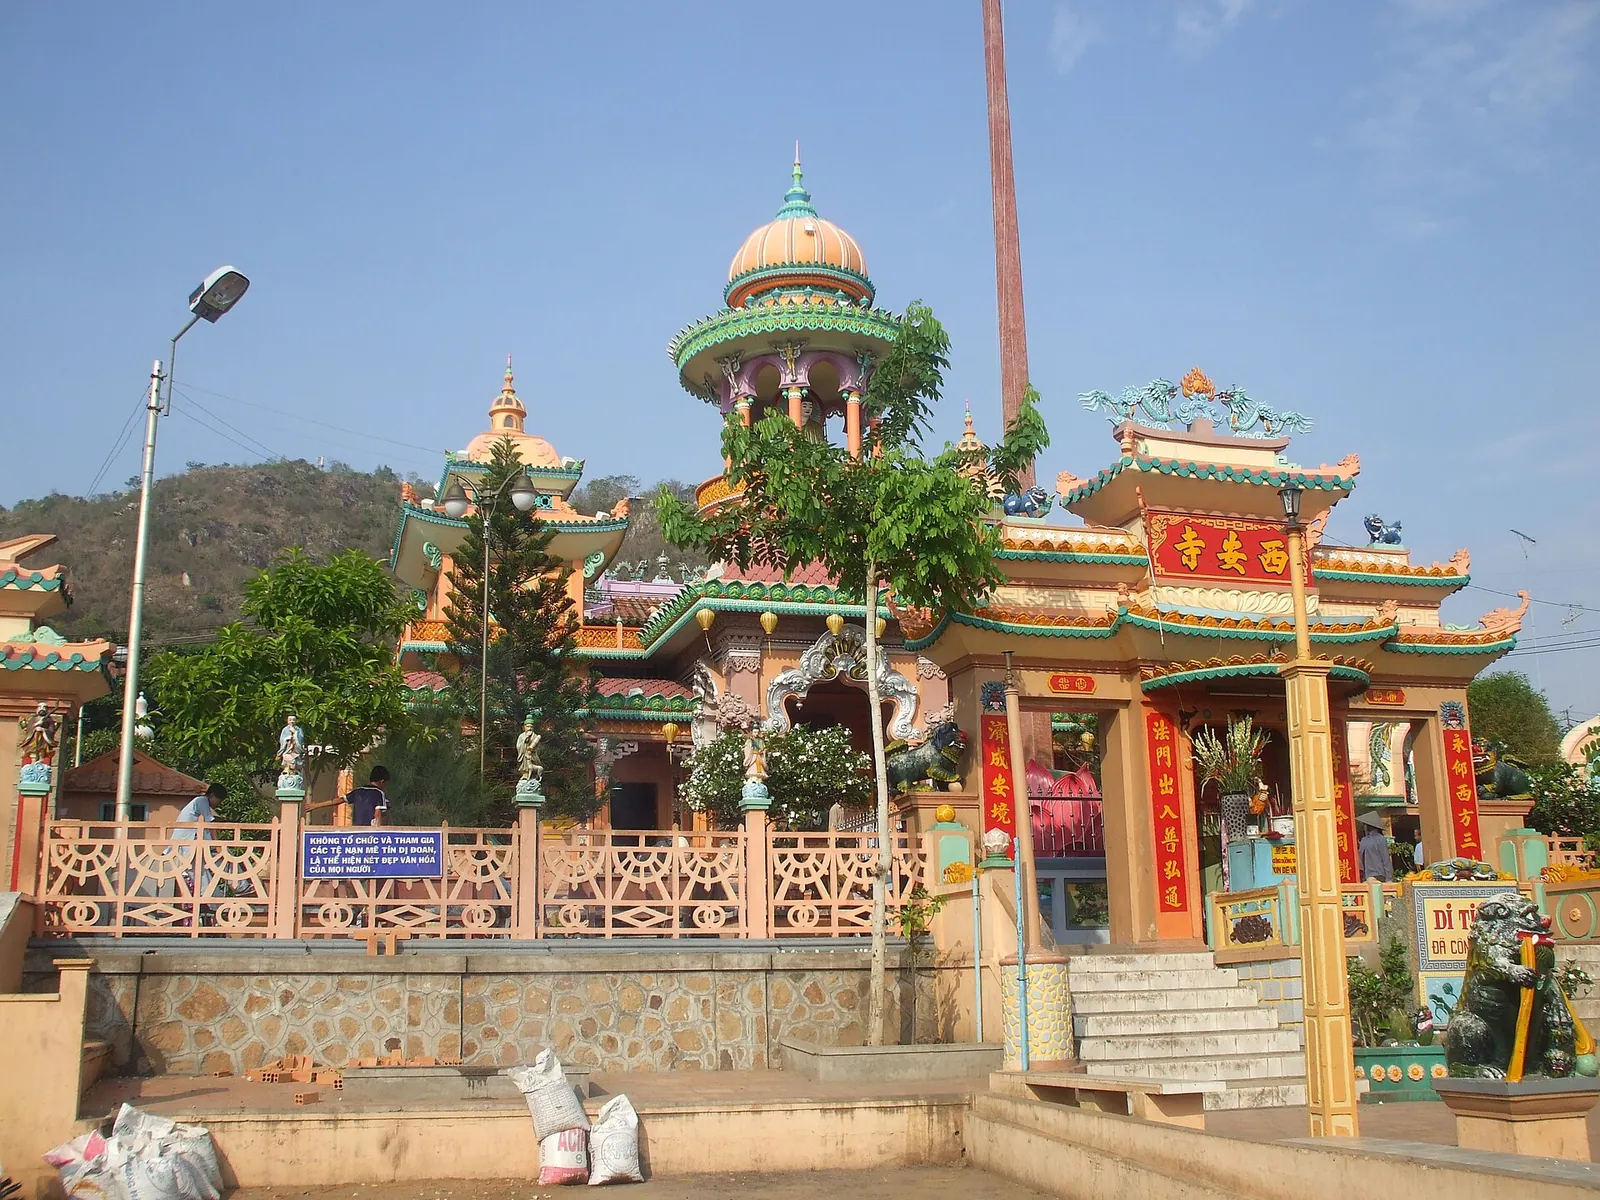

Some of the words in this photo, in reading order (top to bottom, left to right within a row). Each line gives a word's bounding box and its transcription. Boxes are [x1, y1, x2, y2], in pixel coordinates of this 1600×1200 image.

[1452, 733, 1479, 861] 永仰西方三
[310, 836, 340, 845] KHÔNG
[342, 834, 353, 844] TỔ
[355, 835, 379, 844] CHỨC
[380, 836, 392, 844] VÀ
[310, 846, 328, 854] CÁC
[330, 845, 342, 855] TỆ
[344, 847, 363, 856] NẠN
[365, 846, 379, 854] MÊ
[382, 846, 397, 854] TÍN
[398, 847, 408, 856] DỊ
[310, 856, 321, 865] LÀ
[341, 856, 362, 865] HIỆN
[363, 856, 379, 864] NÉT
[381, 857, 399, 866] ĐẸP
[418, 856, 435, 864] HÓA
[309, 865, 326, 874] CỦA
[328, 866, 344, 875] MỌI
[1450, 937, 1470, 954] CÔN
